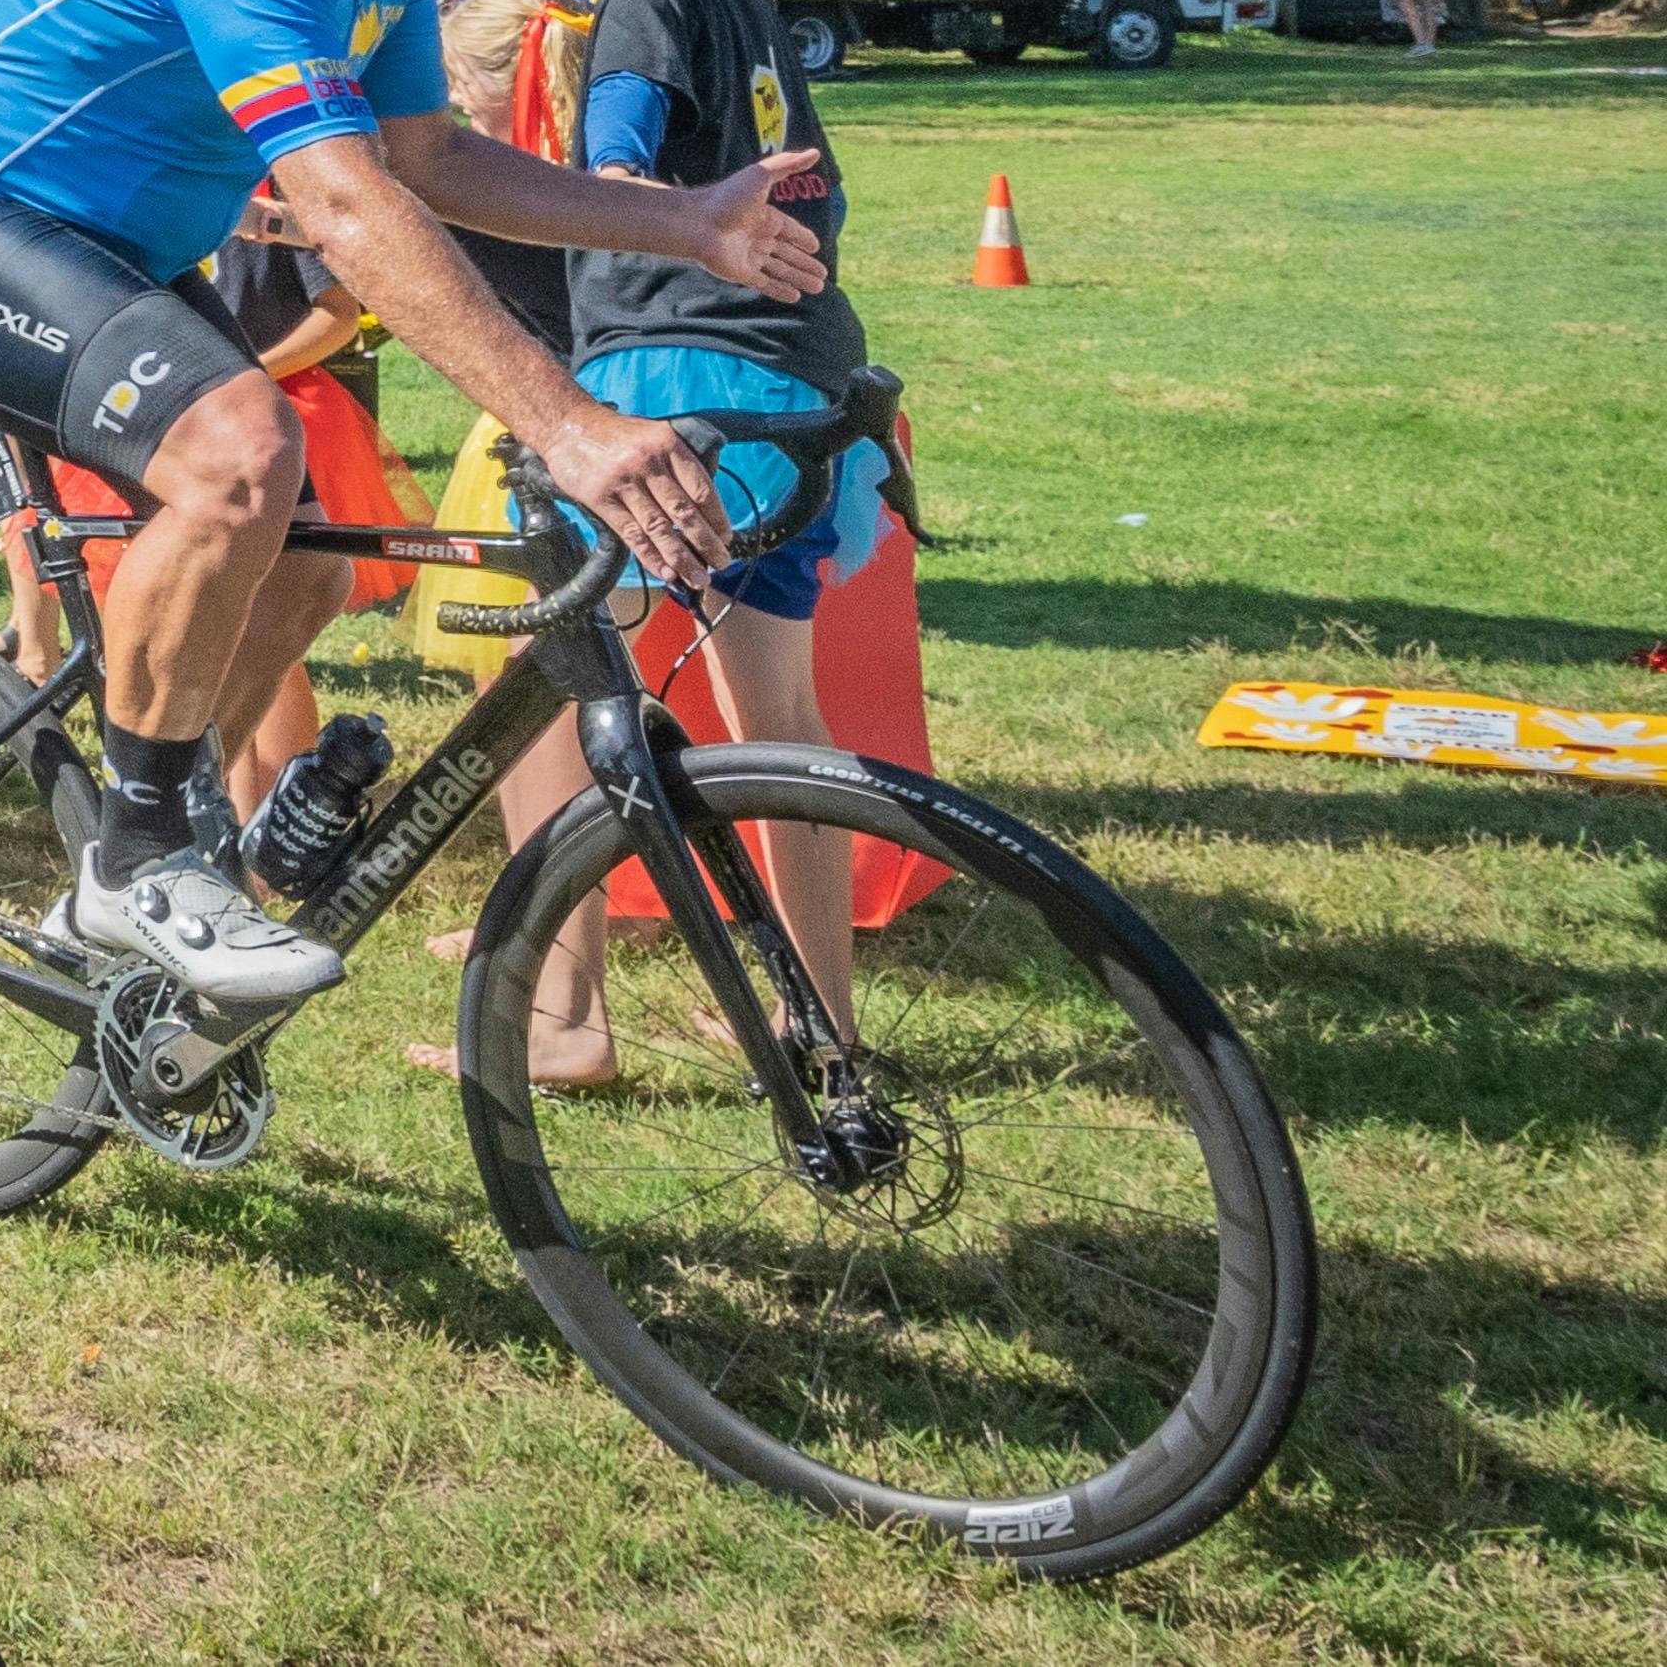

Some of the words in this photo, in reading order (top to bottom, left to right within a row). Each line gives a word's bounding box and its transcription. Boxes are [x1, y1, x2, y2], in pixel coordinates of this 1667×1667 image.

[314, 79, 349, 98] DE
[92, 350, 171, 435] TDC
[387, 539, 475, 561] SRAM
[808, 764, 925, 802] GOODYEAR
[930, 800, 998, 838] EAGLE
[314, 748, 494, 941] annondale
[963, 1517, 1075, 1544] ZIPP
